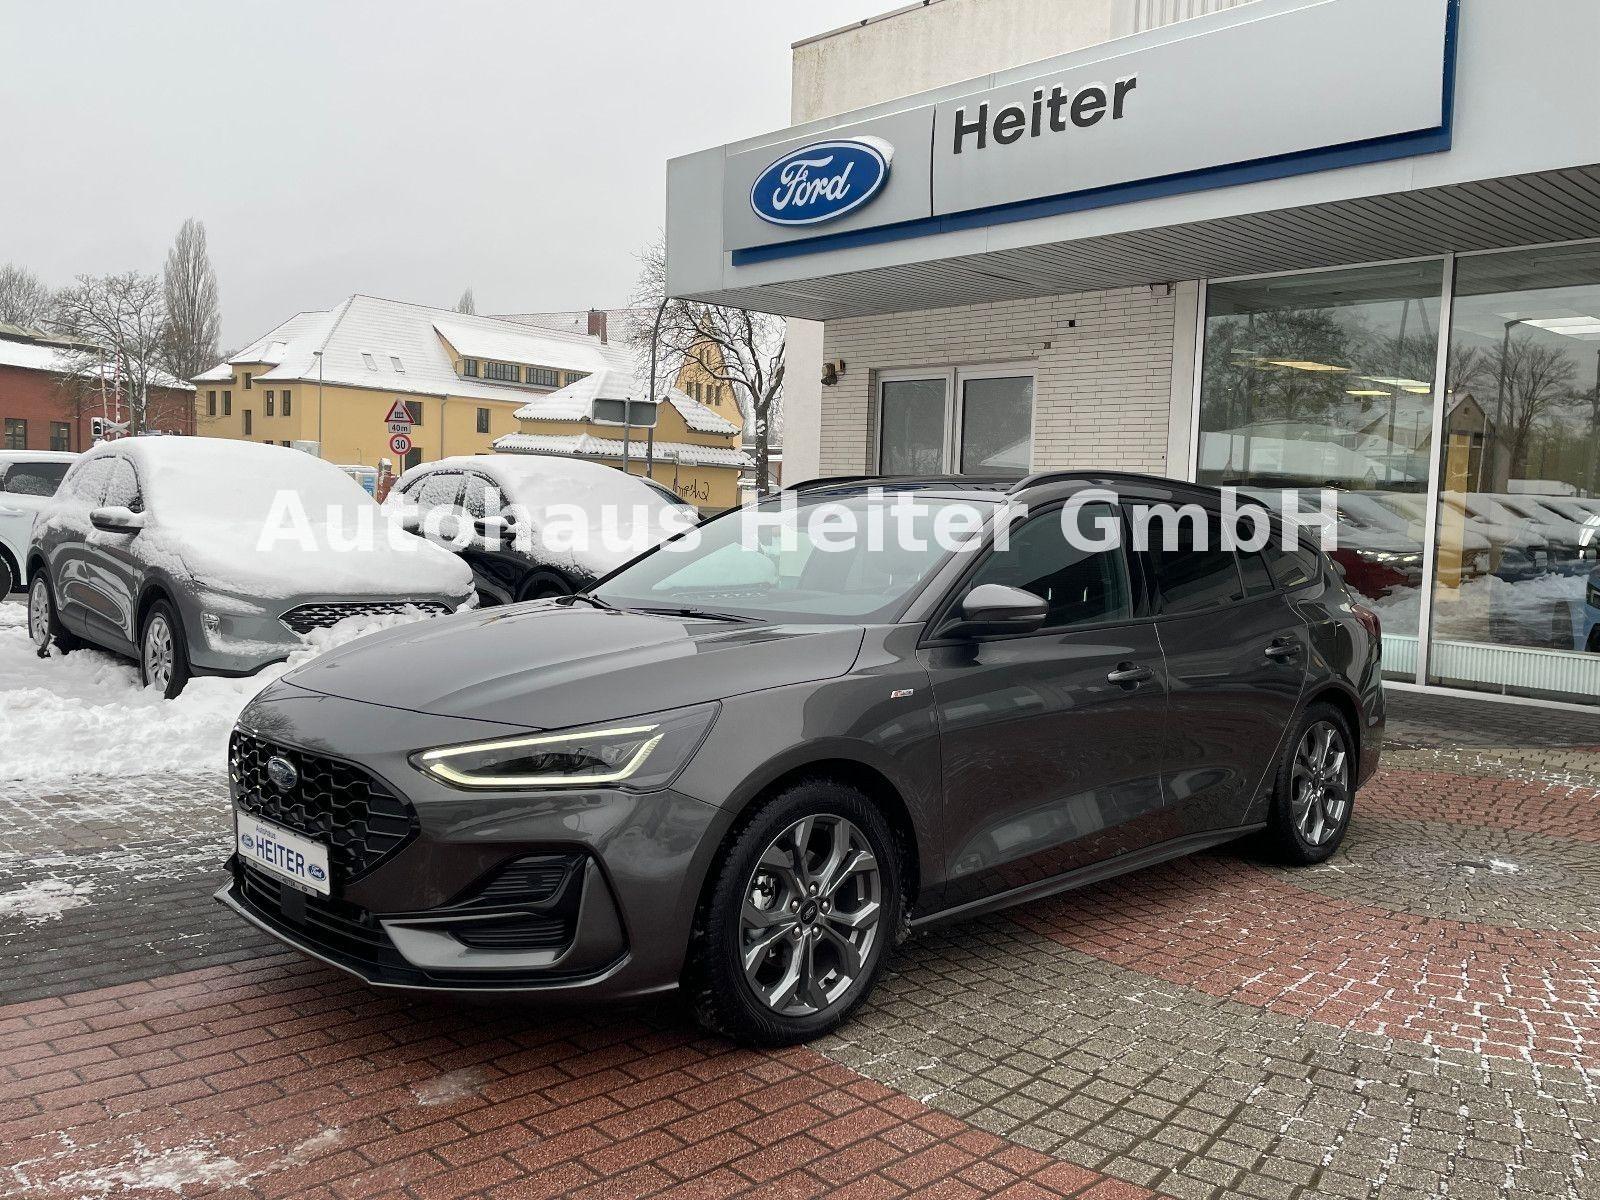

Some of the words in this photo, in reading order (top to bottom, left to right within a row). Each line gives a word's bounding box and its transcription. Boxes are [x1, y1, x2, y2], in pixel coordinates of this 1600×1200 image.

[953, 75, 1138, 155] Heiter
[772, 154, 855, 211] Ford
[395, 439, 406, 450] 30
[256, 835, 305, 877] HEITER
